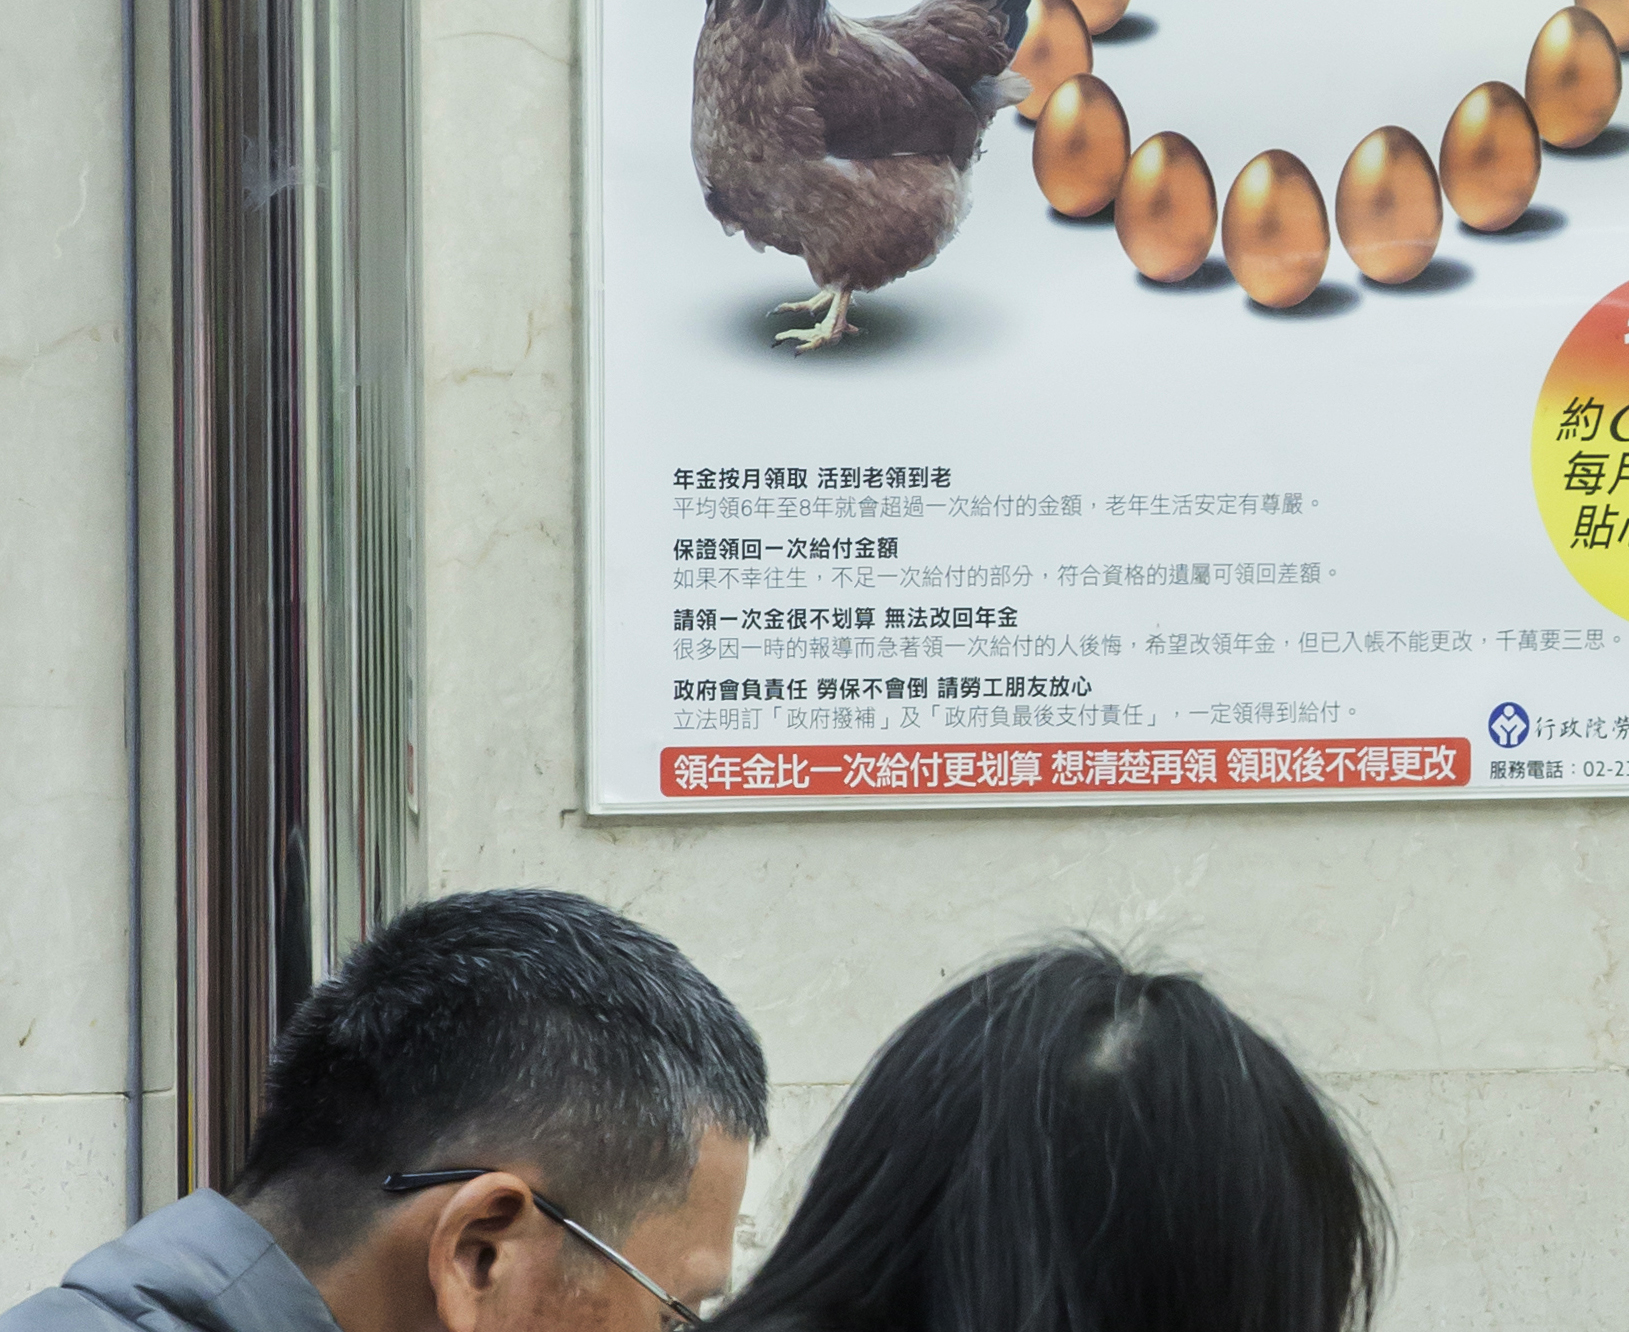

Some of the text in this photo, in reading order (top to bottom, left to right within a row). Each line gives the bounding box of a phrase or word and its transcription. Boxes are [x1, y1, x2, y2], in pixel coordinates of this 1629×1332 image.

[672, 465, 952, 491] 年金按月領取 活到老領到老
[672, 536, 899, 561] 保證領回一次給付金額
[673, 605, 1019, 632] 請領一次金很不划算 無法改回年金
[673, 674, 1093, 702] 政府會負責任 勞保不會倒 請勞工朋友放心
[674, 744, 1456, 791] 領年金比一次給付更划算 想清楚再領 領取後不得更改
